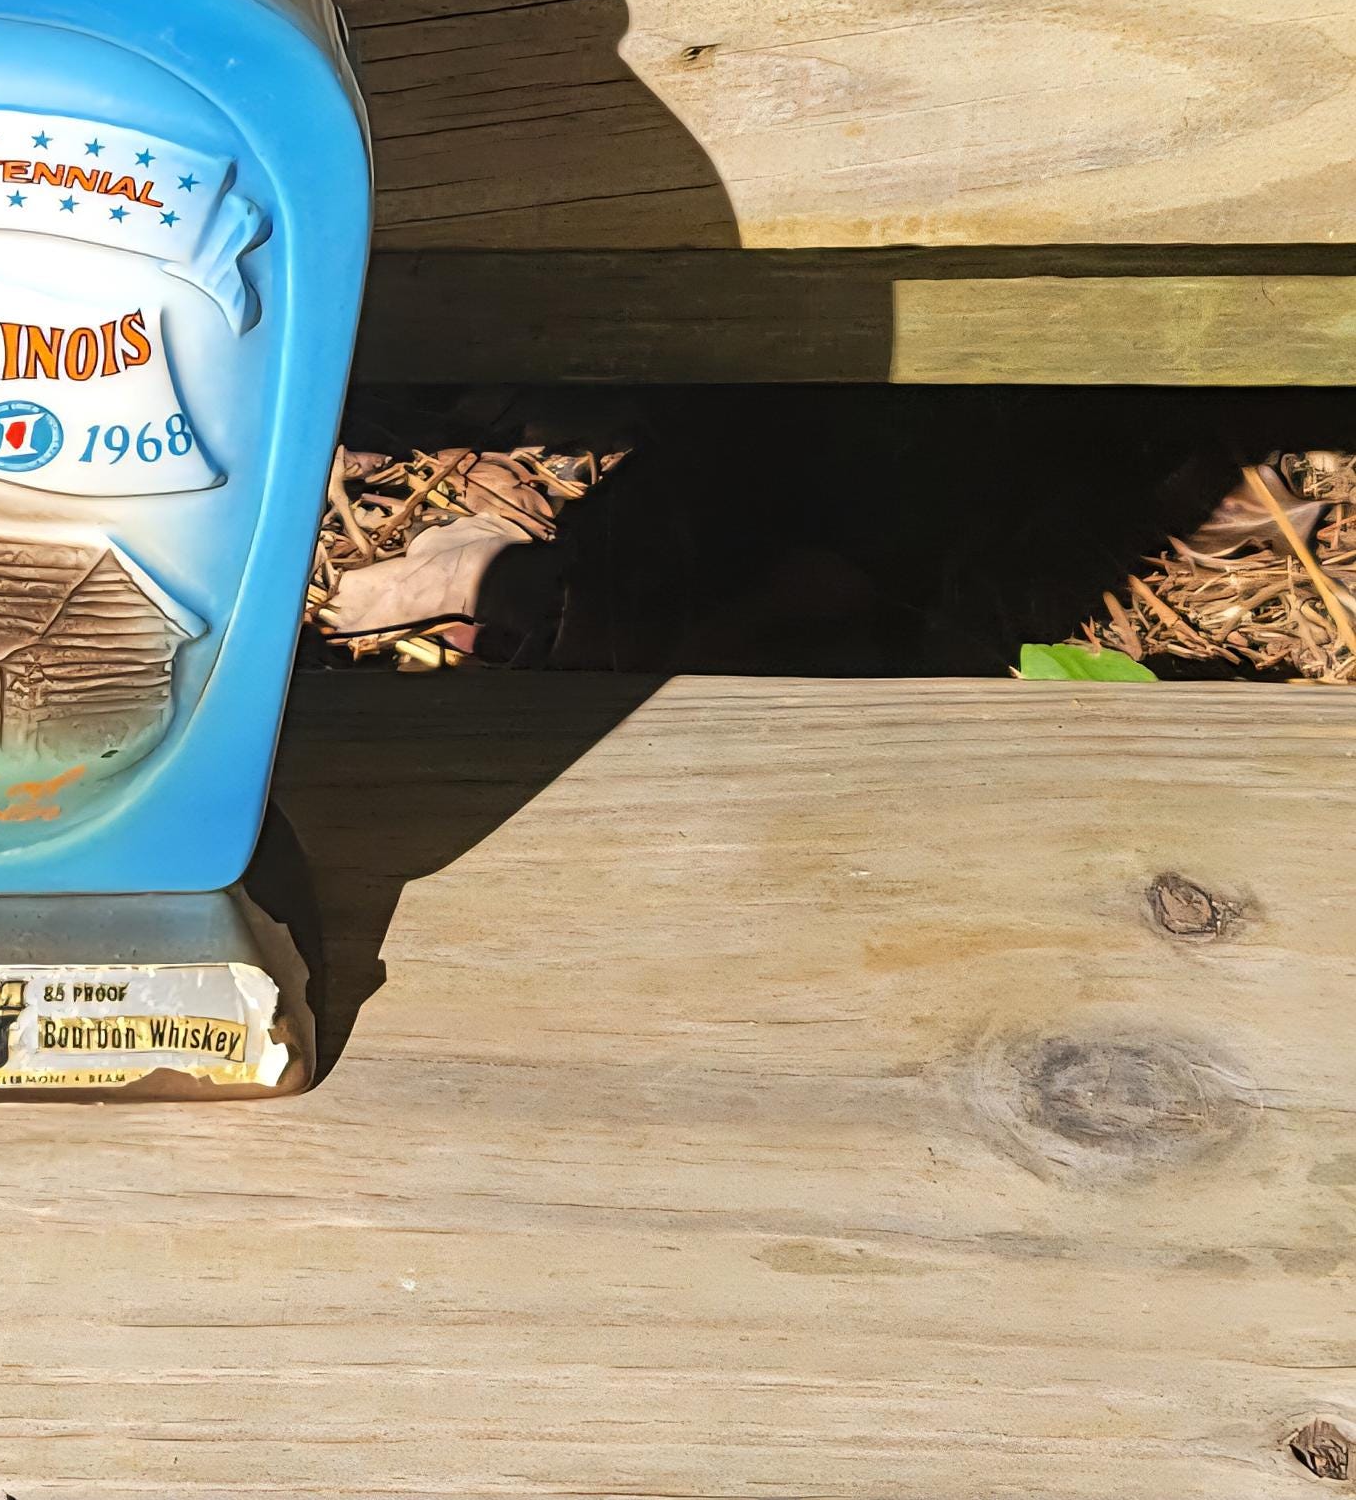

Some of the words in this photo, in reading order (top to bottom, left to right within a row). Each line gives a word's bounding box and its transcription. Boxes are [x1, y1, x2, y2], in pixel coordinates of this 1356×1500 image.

[78, 411, 195, 465] 1968
[72, 982, 131, 1003] PROOF
[43, 1019, 137, 1051] Bourbon
[149, 1018, 242, 1062] Whiskey
